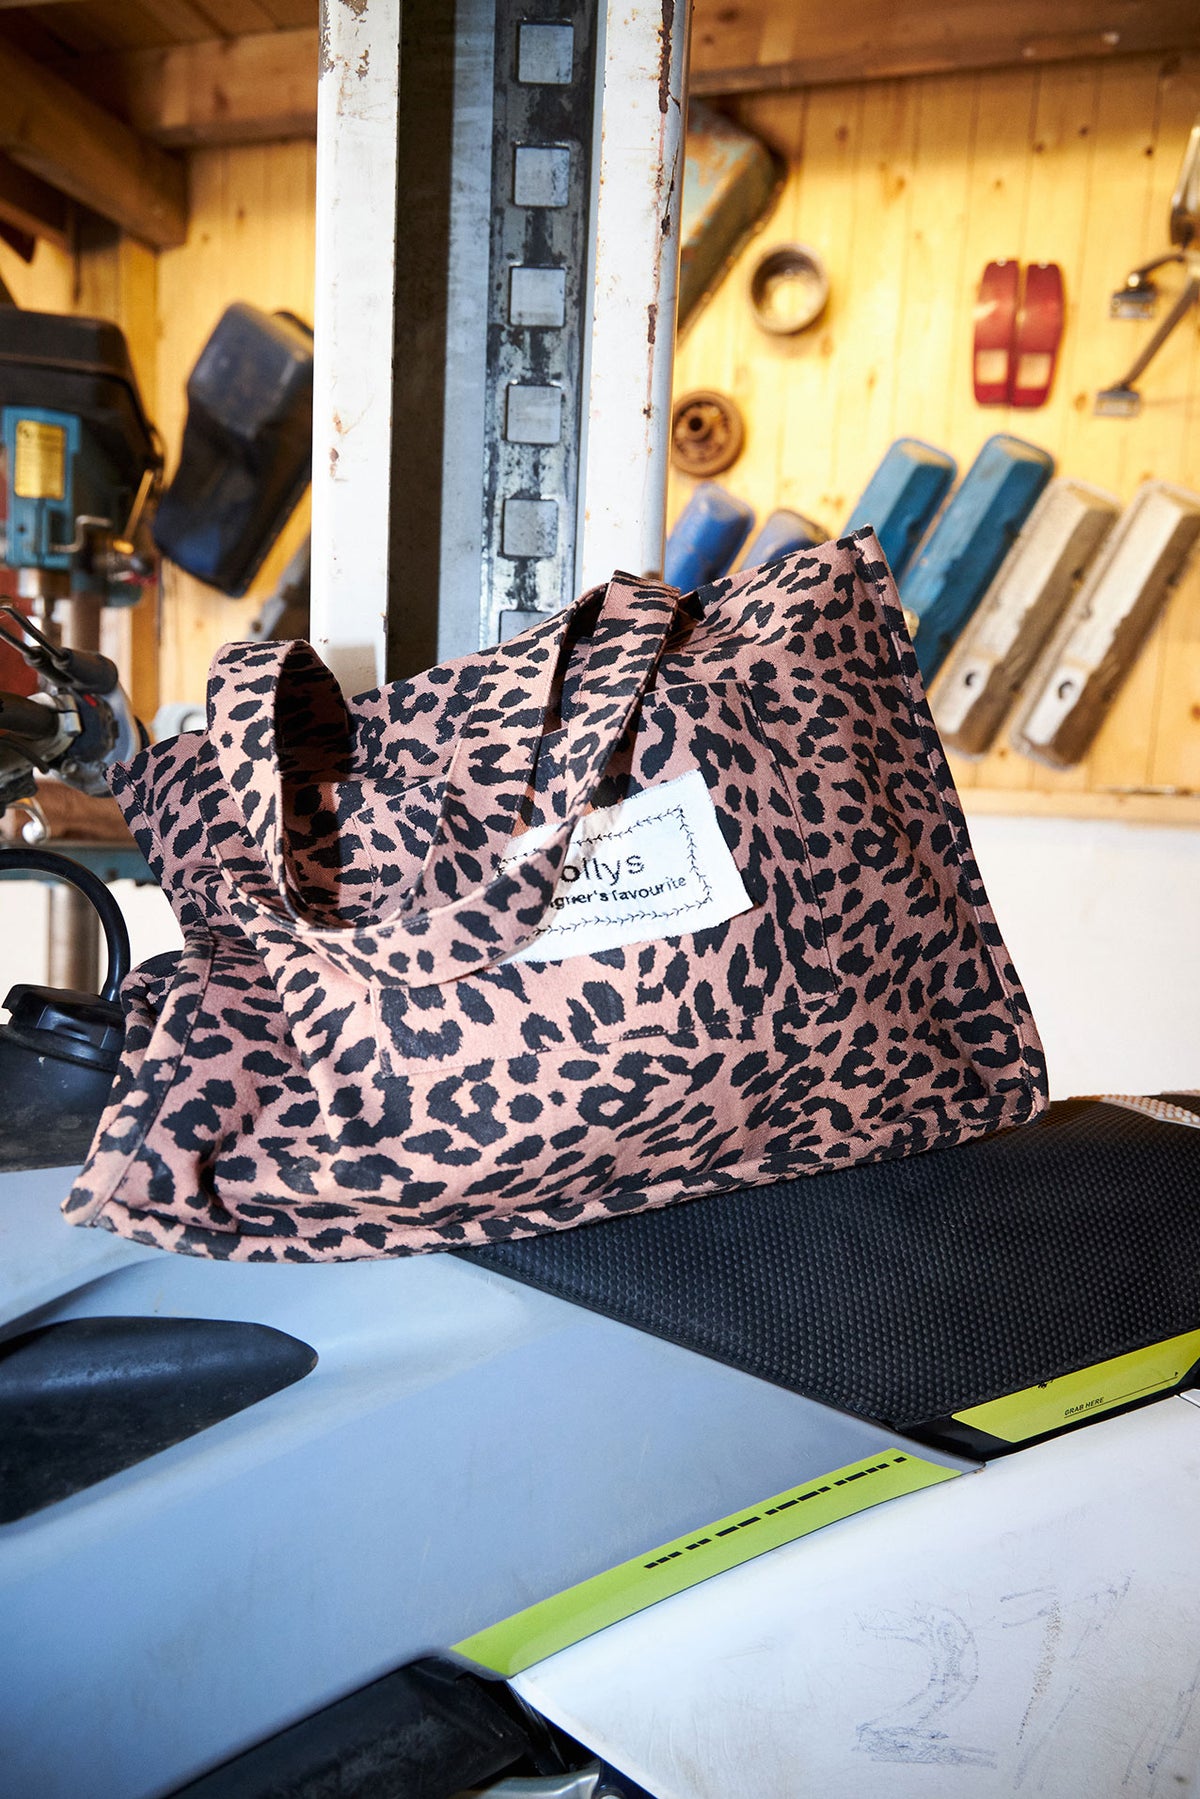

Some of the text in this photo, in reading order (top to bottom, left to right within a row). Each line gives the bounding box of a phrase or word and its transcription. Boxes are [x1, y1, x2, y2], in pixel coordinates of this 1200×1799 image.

[560, 855, 645, 886] ollys
[612, 876, 687, 901] favourite
[1064, 1396, 1104, 1416] GRAB HERE
